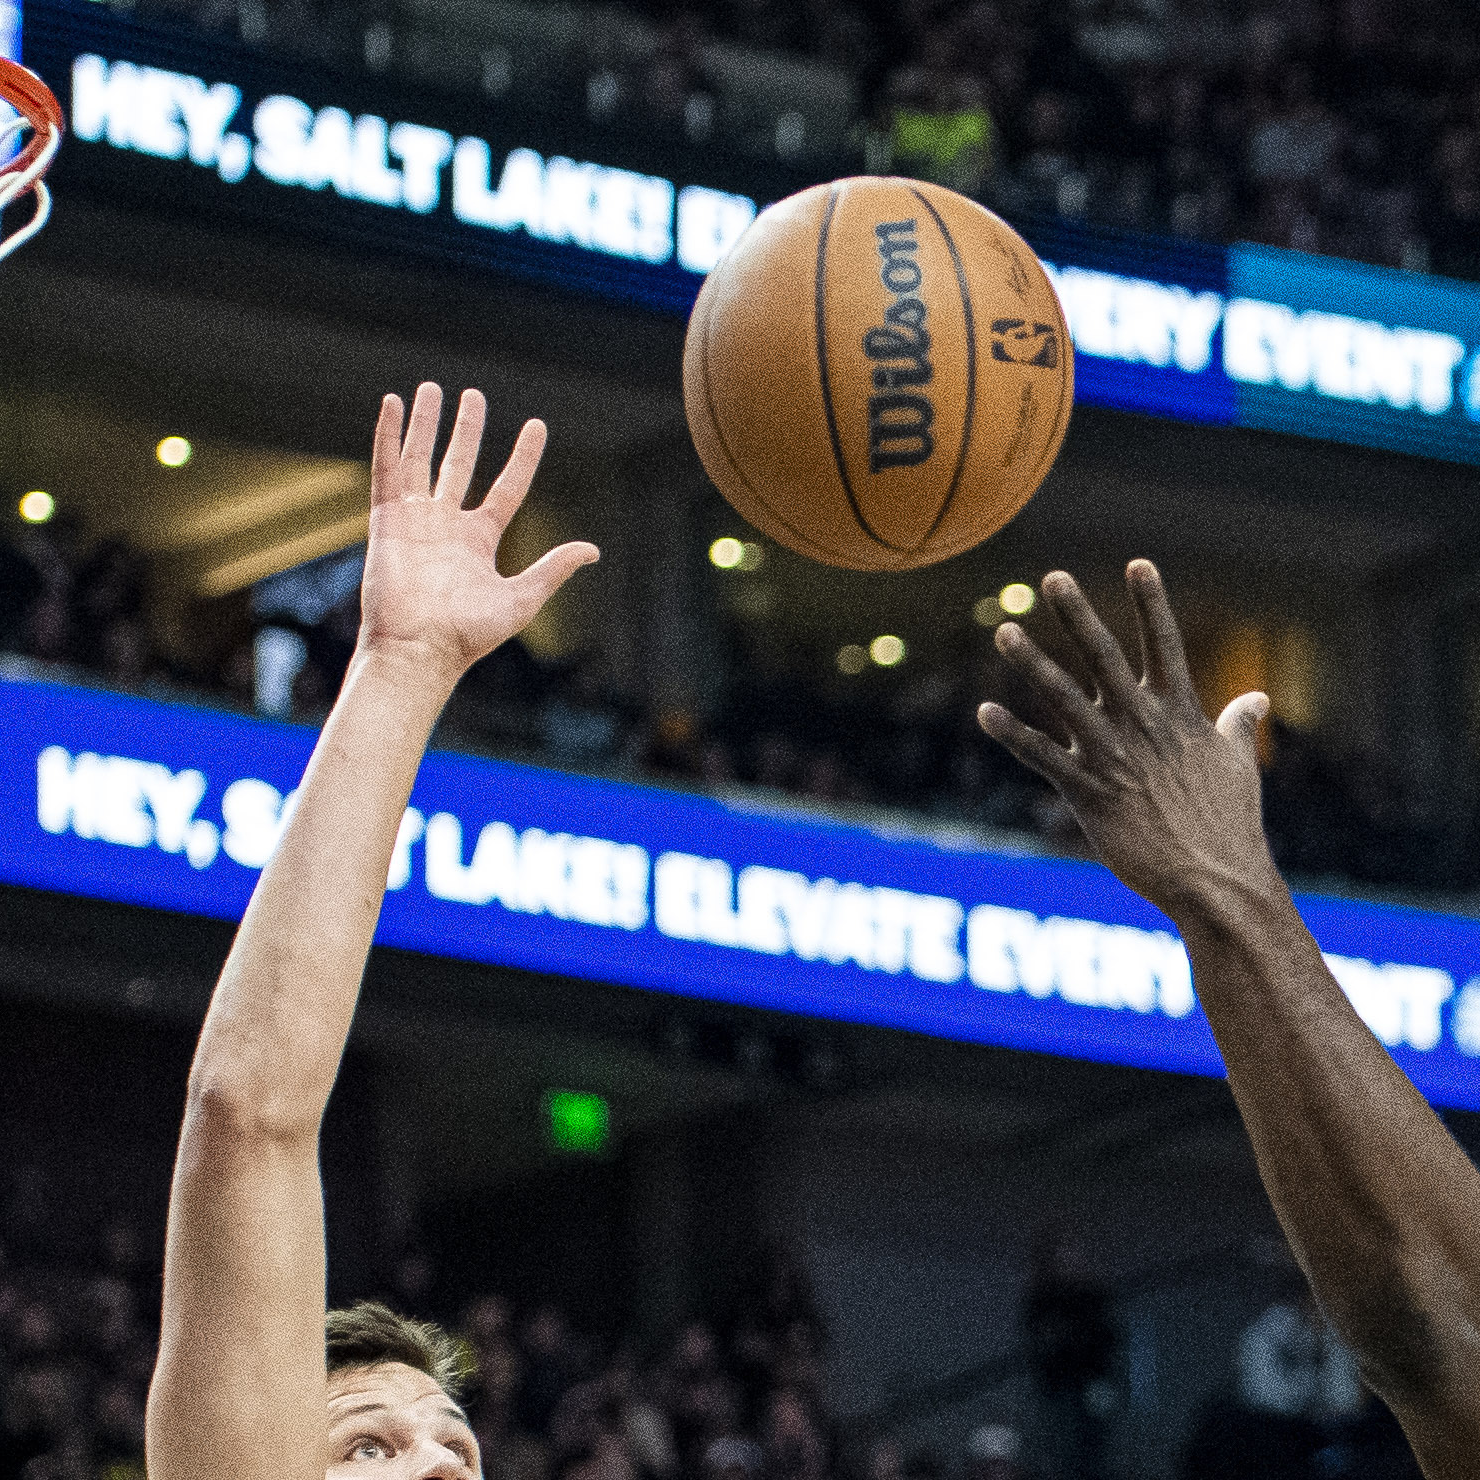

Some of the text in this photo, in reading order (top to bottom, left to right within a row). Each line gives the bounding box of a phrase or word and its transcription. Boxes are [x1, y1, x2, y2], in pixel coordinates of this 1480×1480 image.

[72, 54, 251, 184] HEY,
[252, 94, 453, 216] SALT
[863, 217, 934, 474] Wilson
[1039, 266, 1223, 372] VERY
[1222, 298, 1465, 416] EVENT
[37, 745, 221, 870] HEY,
[654, 850, 967, 984] ELEVATE
[966, 904, 1196, 1018] EVERY
